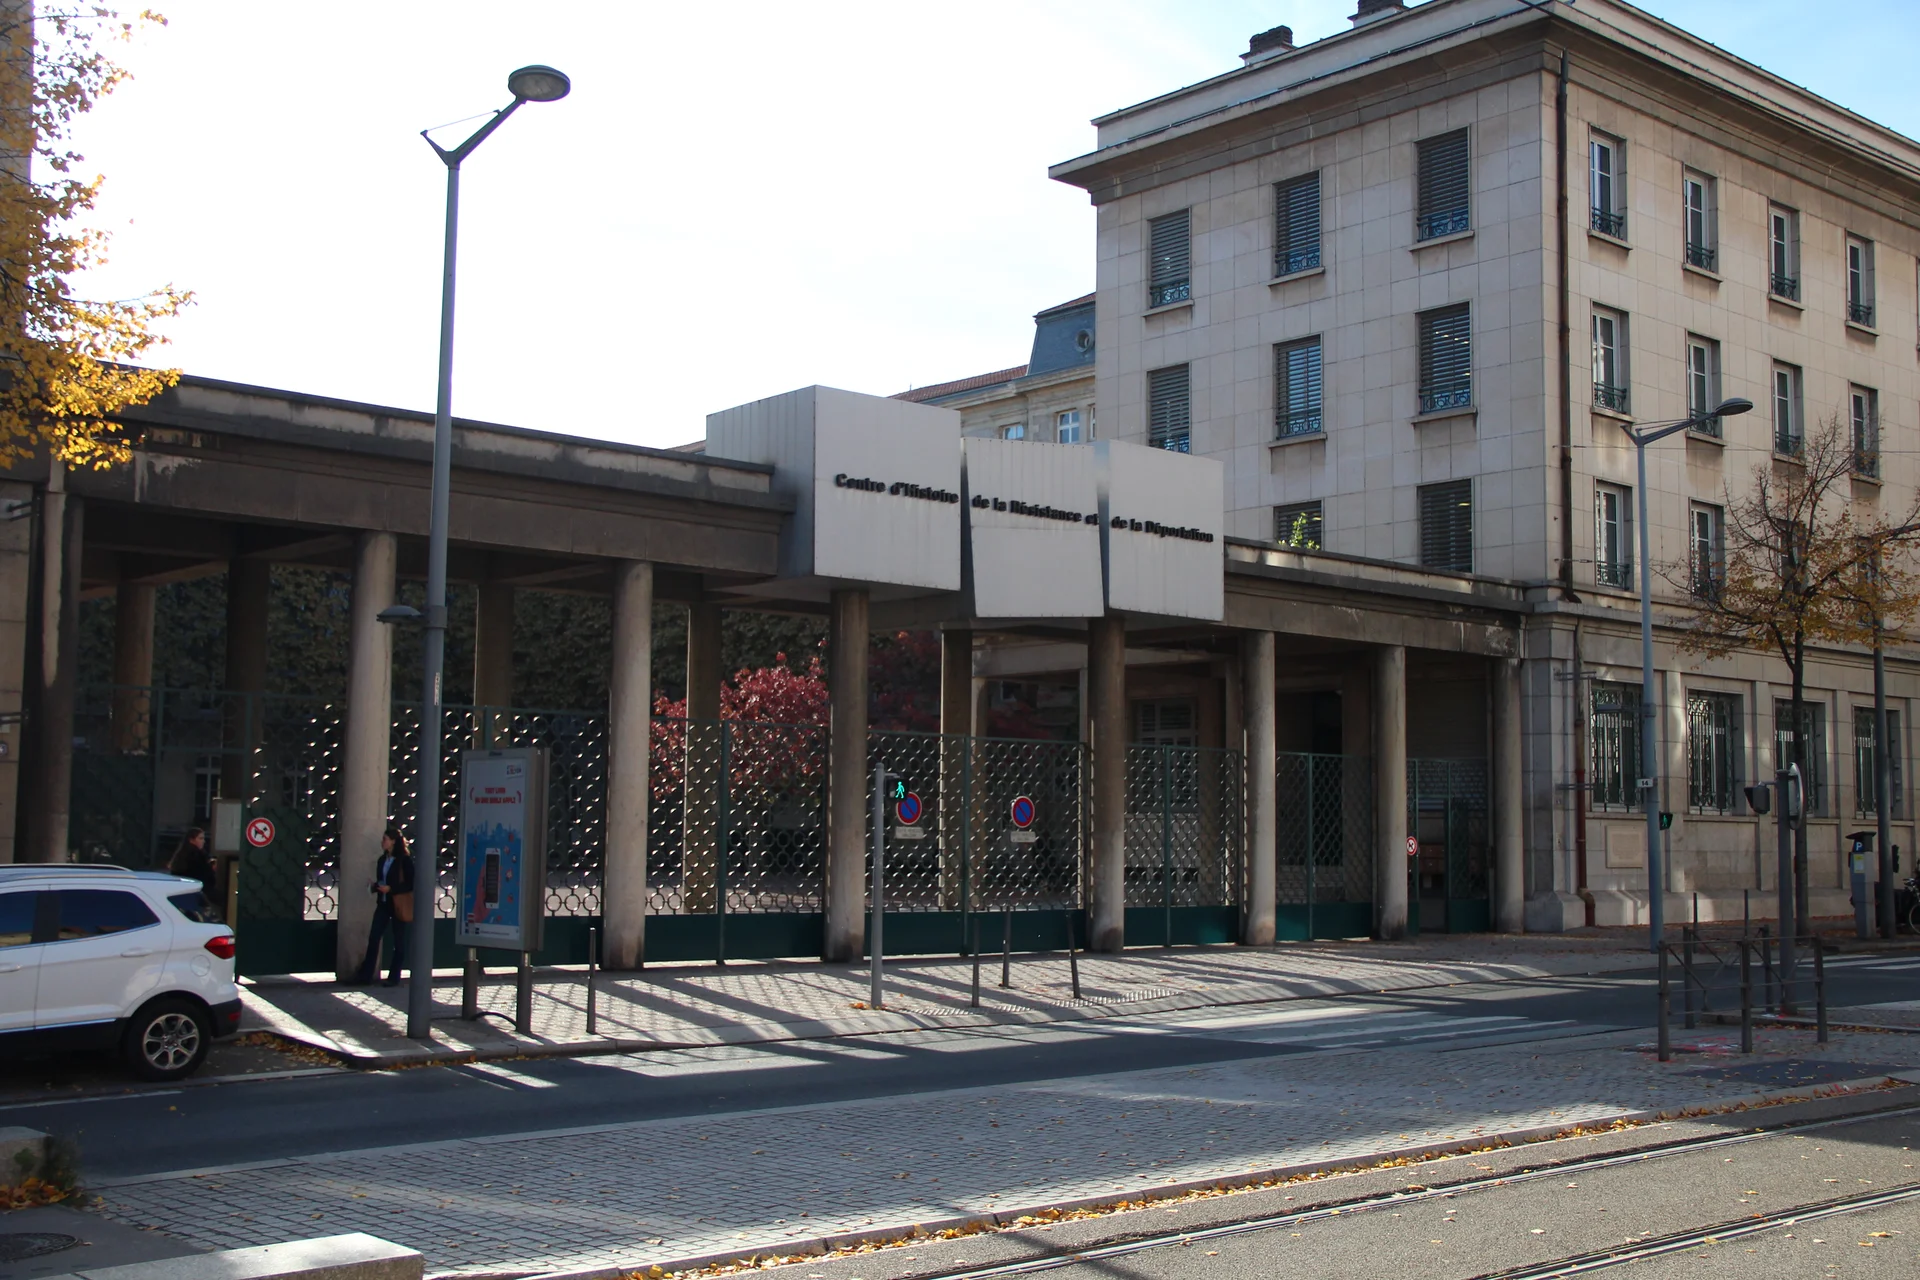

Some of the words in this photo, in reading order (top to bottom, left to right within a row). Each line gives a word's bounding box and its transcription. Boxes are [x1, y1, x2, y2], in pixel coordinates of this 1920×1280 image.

[835, 473, 886, 493] Centre
[890, 482, 959, 504] d'Histoire
[972, 495, 990, 509] de
[993, 497, 1007, 512] la
[1010, 500, 1083, 522] Résistance
[1085, 513, 1099, 526] et
[1111, 516, 1128, 529] de
[1130, 518, 1143, 532] la
[1145, 521, 1214, 542] Déportation
[1856, 841, 1863, 851] P
